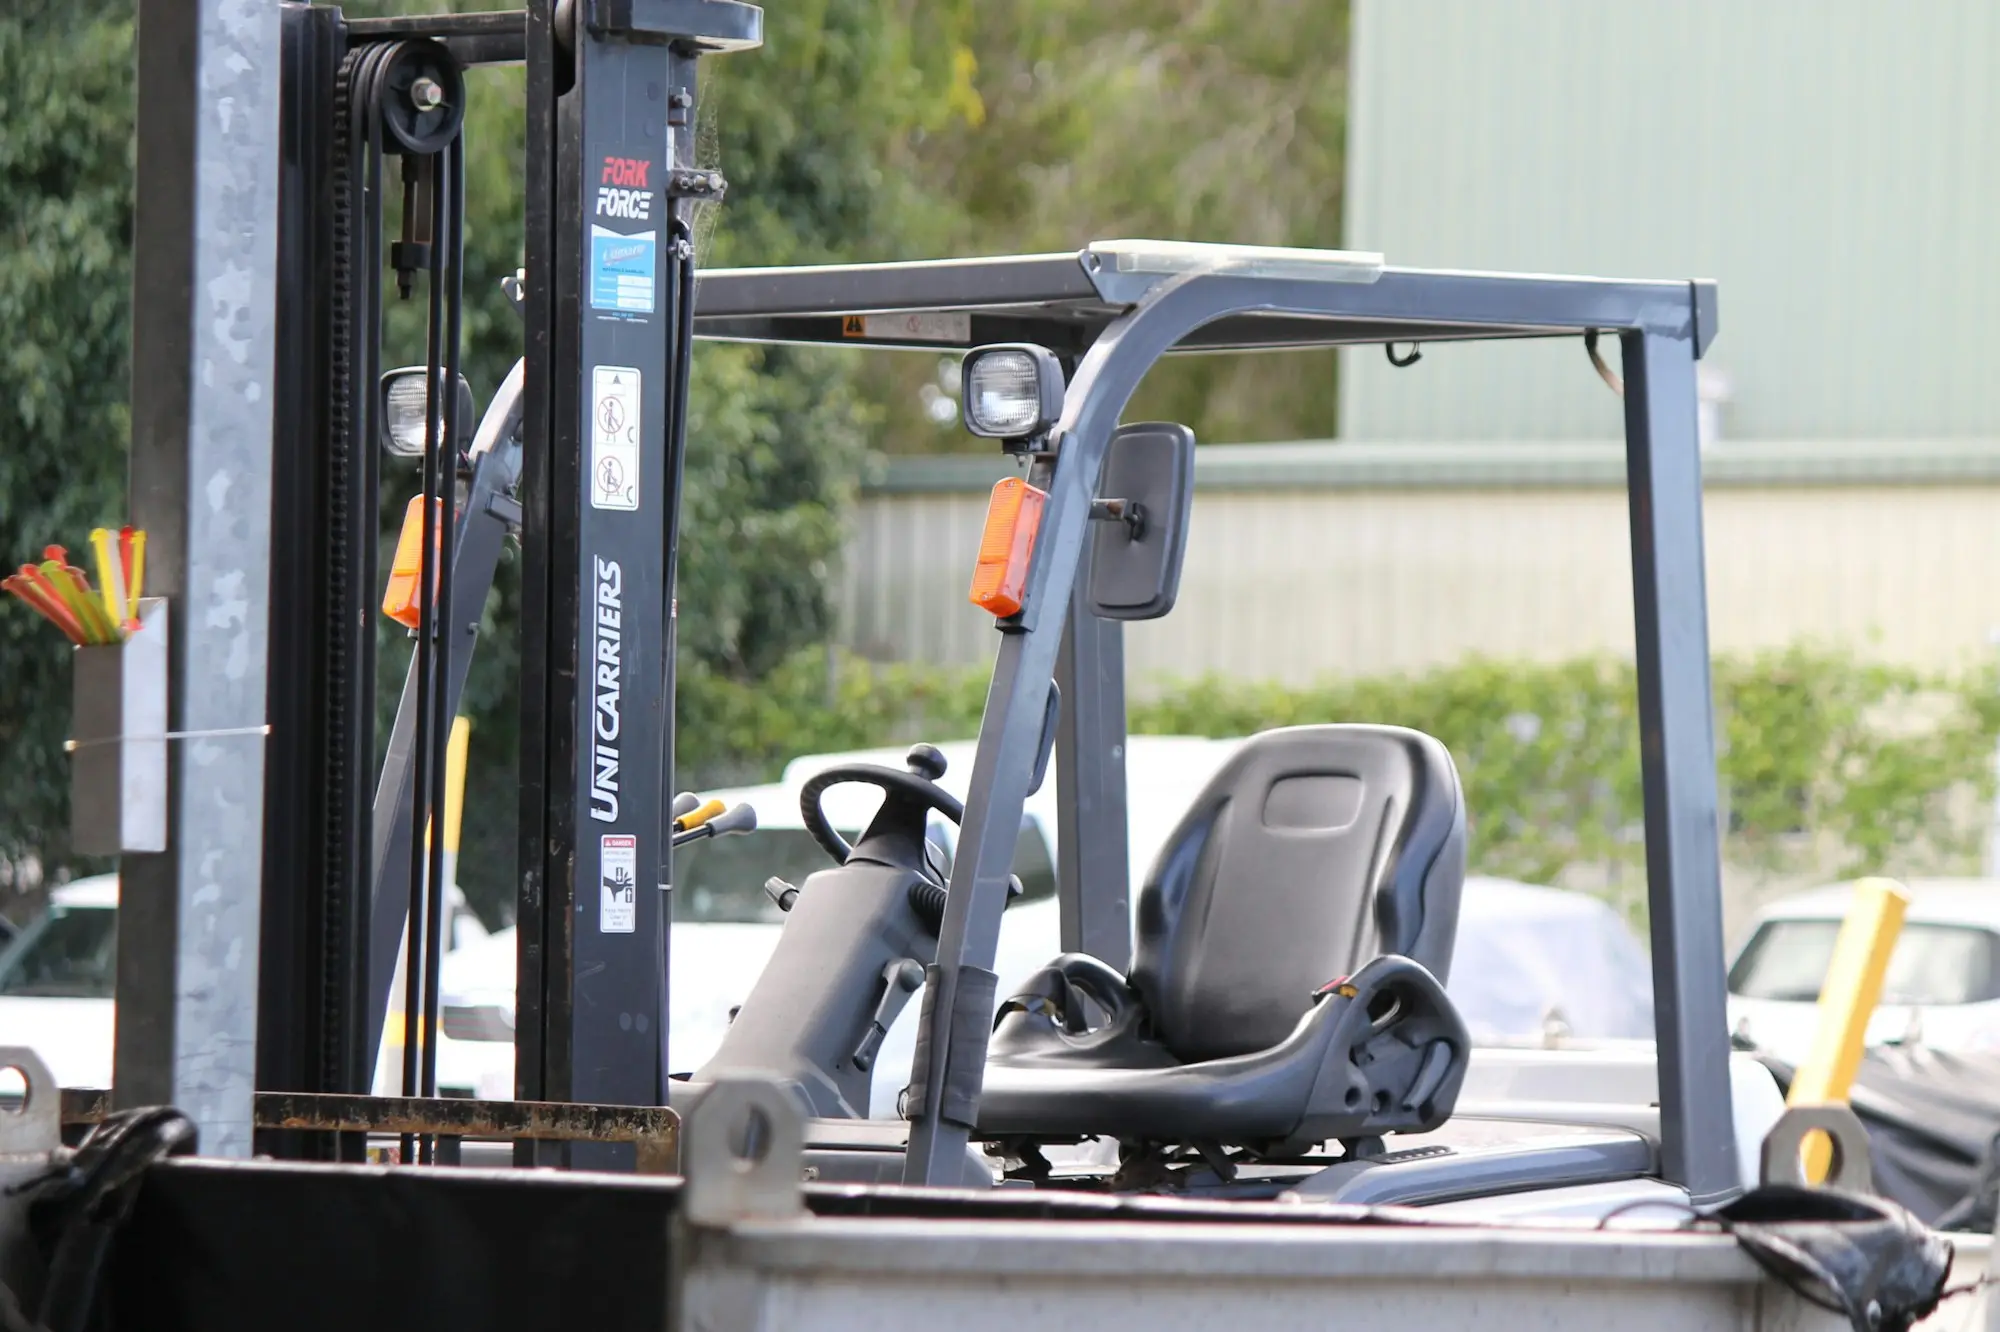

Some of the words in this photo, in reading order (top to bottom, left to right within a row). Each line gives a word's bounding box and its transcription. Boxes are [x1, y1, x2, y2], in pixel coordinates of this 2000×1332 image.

[602, 156, 651, 188] FORK
[596, 186, 653, 220] FORCE
[591, 554, 622, 823] UNICARRIERS
